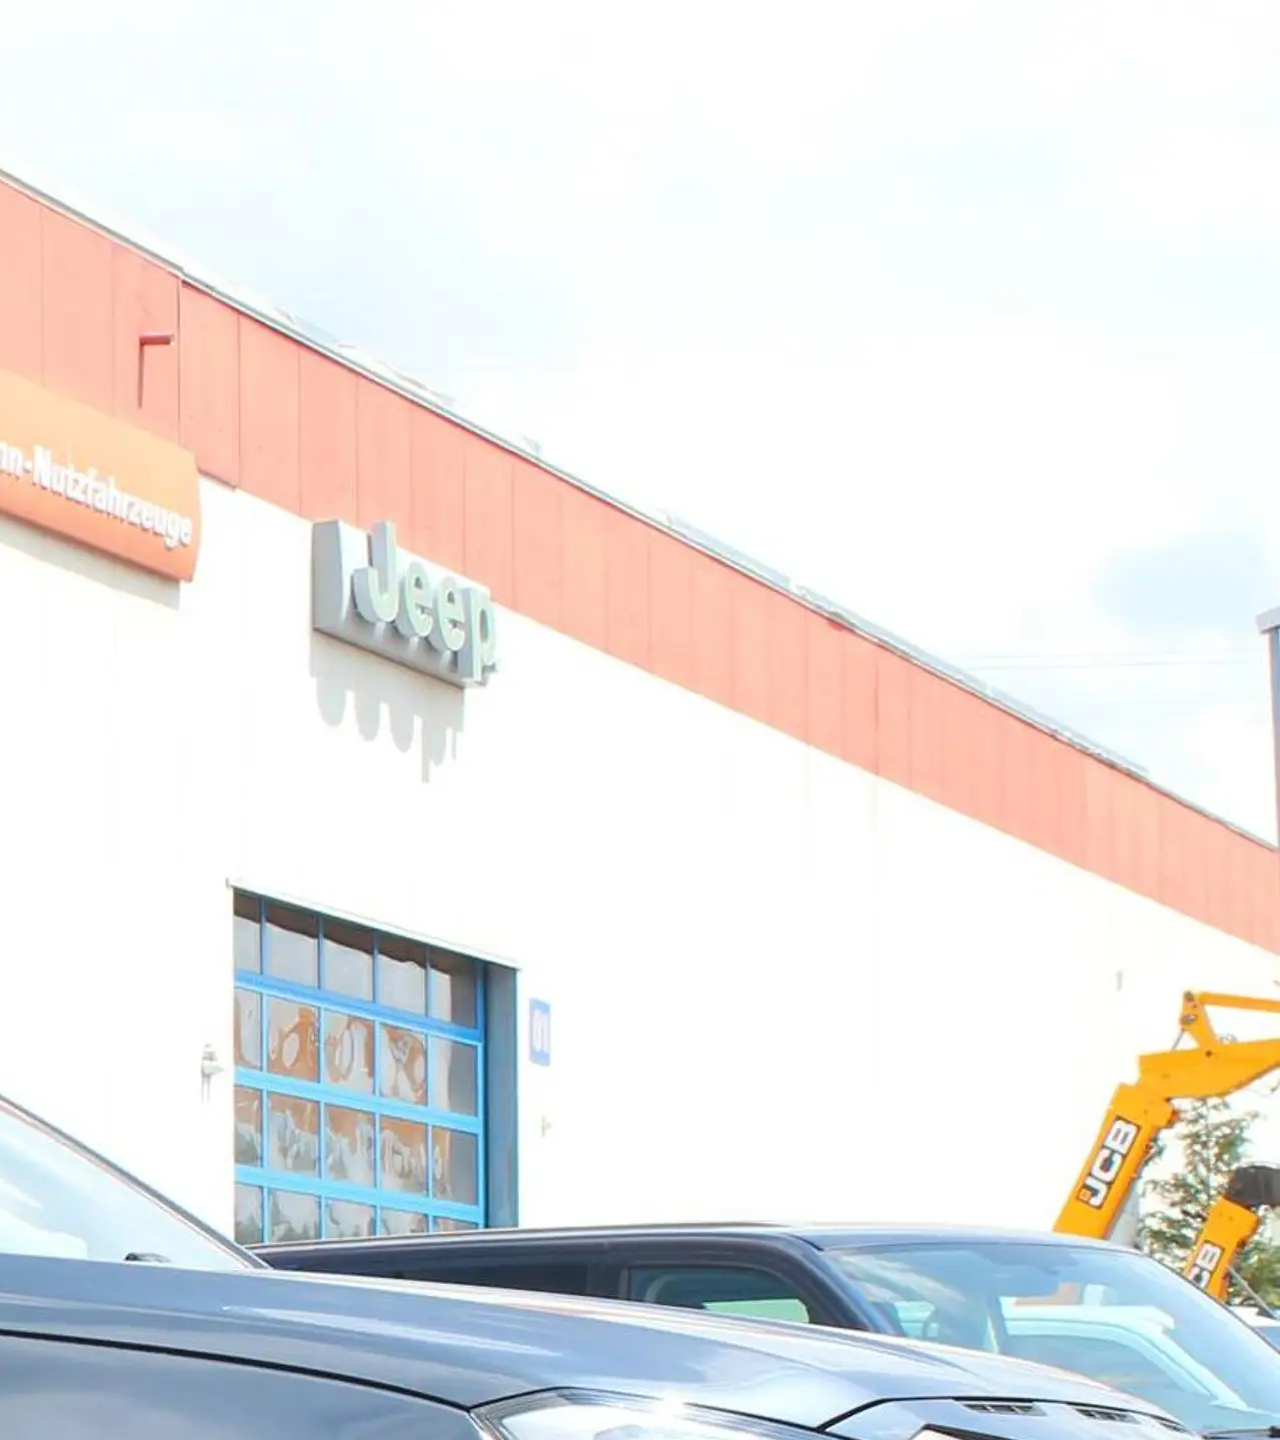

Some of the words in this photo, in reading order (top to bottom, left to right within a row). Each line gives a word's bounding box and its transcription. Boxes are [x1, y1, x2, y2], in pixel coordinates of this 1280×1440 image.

[350, 520, 496, 688] Jeep
[1077, 1117, 1141, 1210] JCB
[1187, 1242, 1223, 1288] CB
